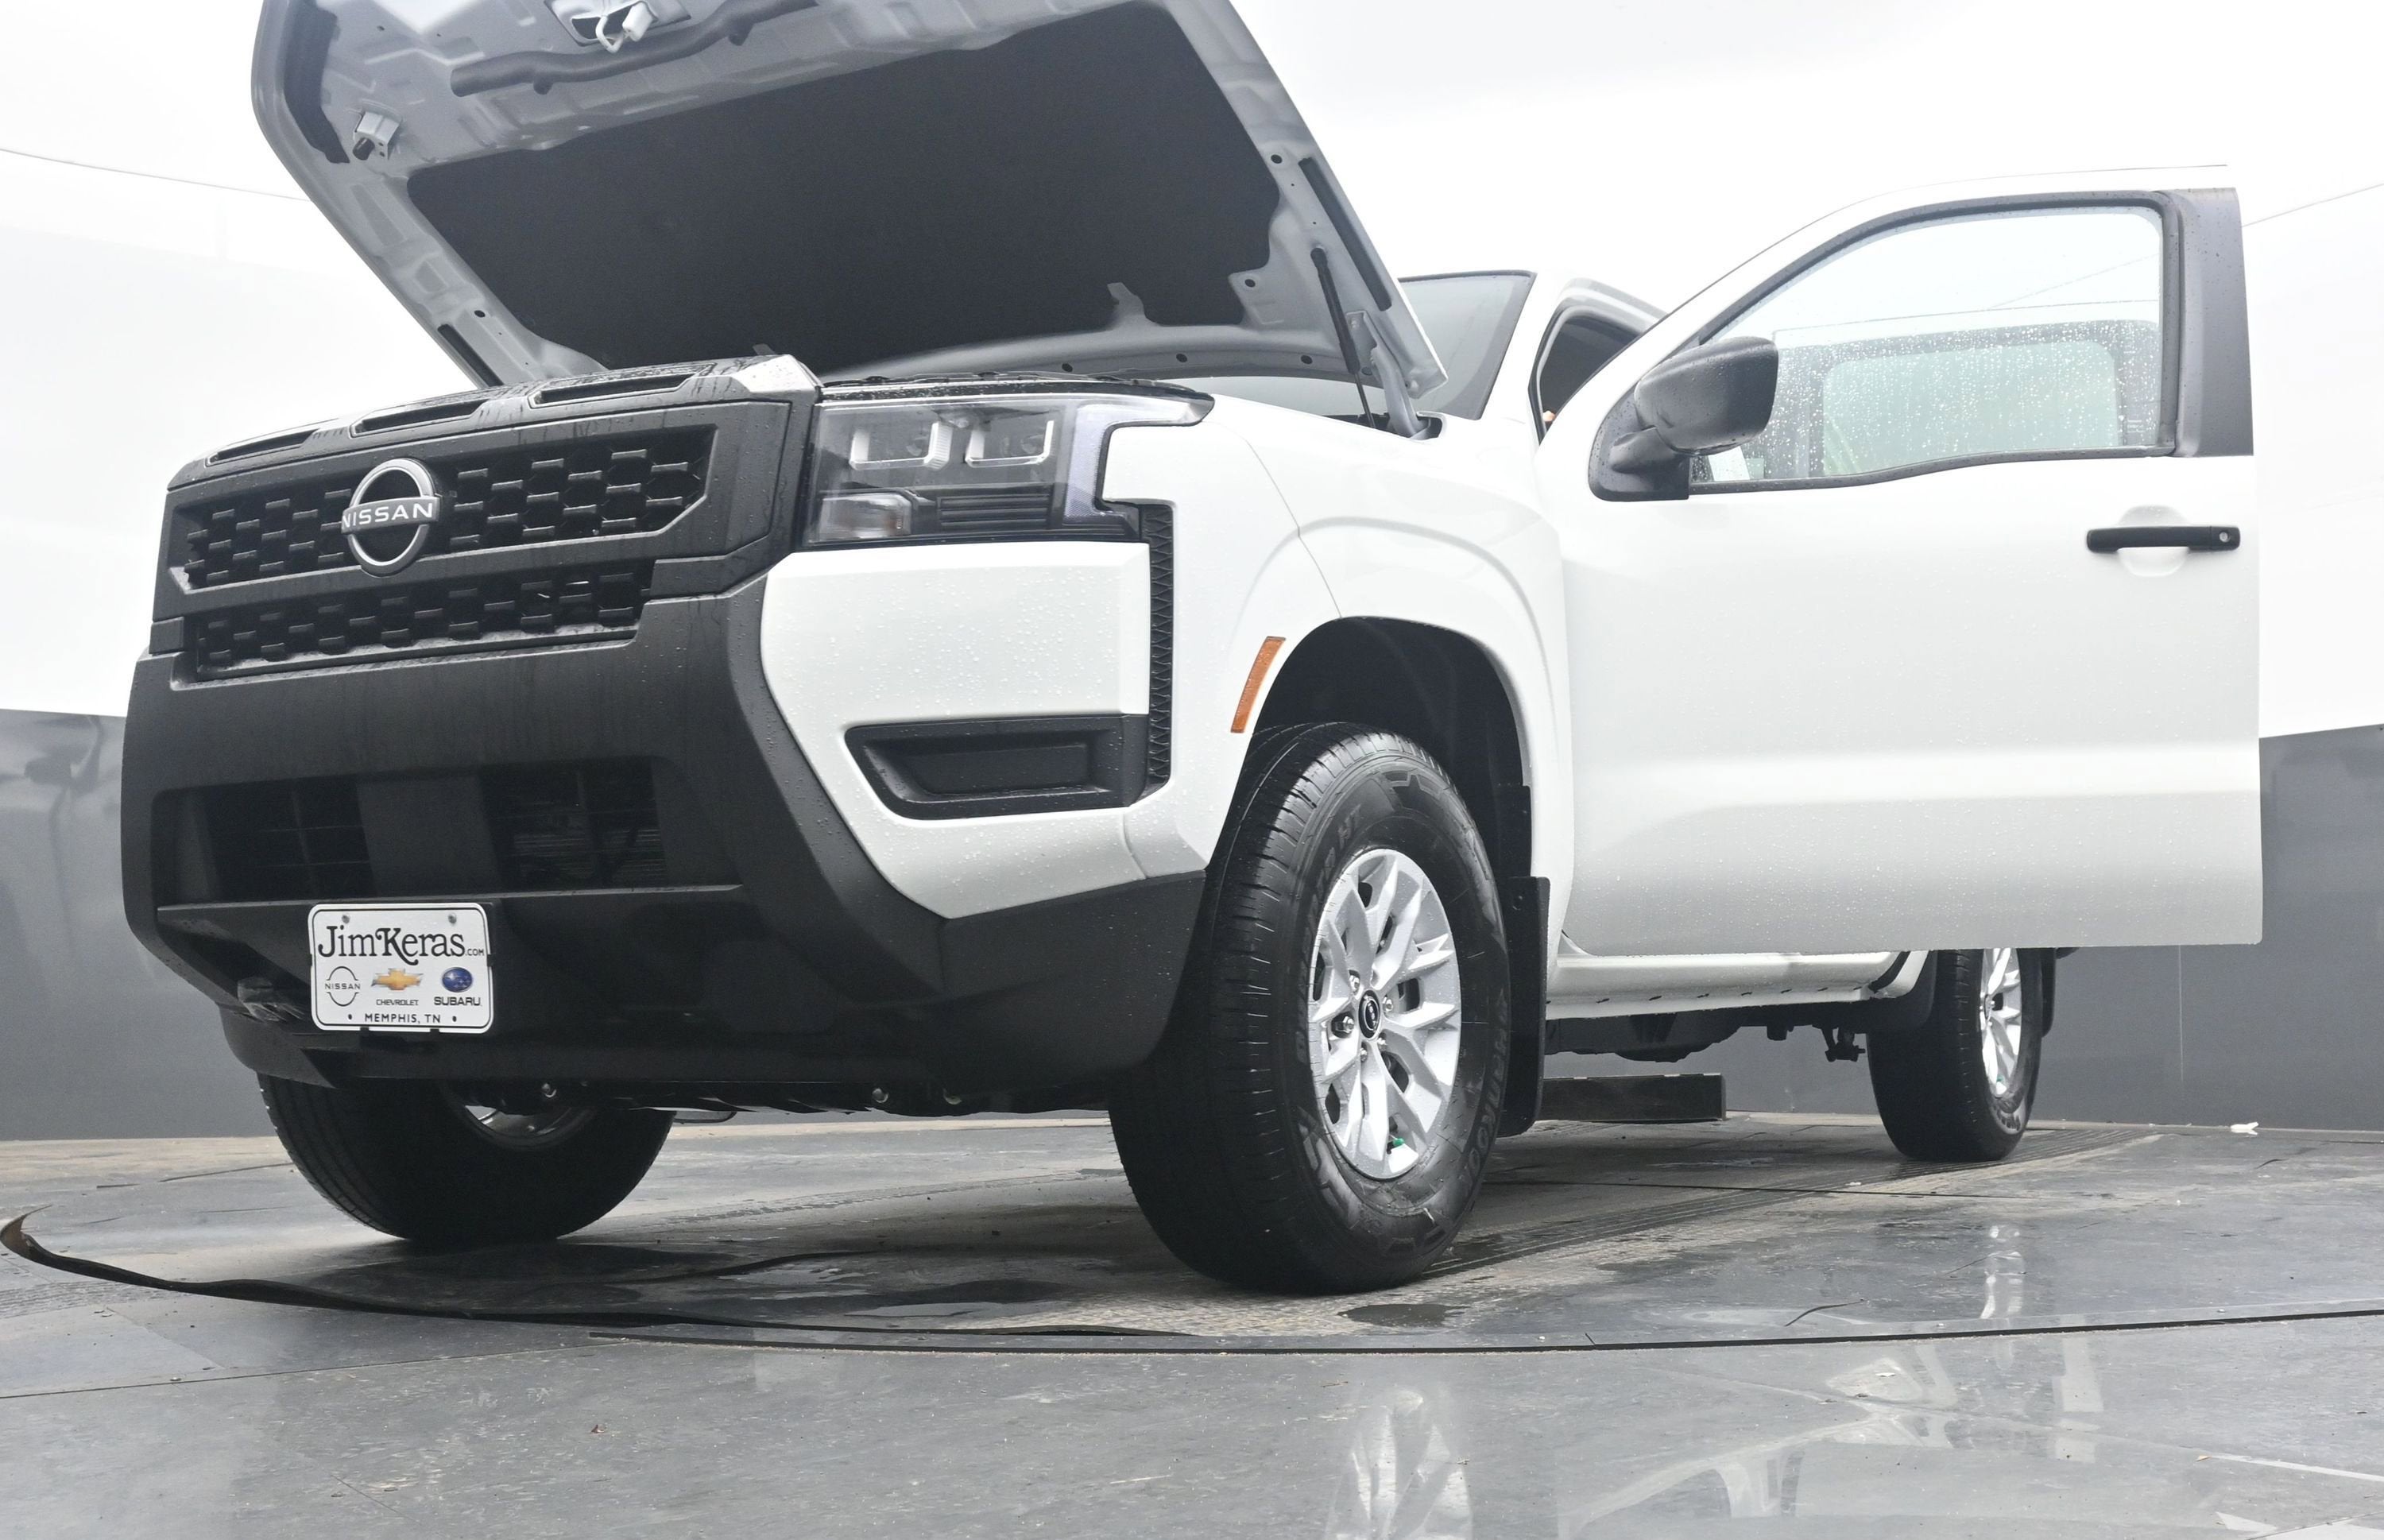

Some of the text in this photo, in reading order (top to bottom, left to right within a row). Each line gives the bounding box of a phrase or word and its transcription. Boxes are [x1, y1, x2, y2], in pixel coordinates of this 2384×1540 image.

[343, 502, 433, 528] NISSAN
[434, 996, 481, 1006] SUBARU
[365, 1013, 441, 1024] MEMPHIS, TN
